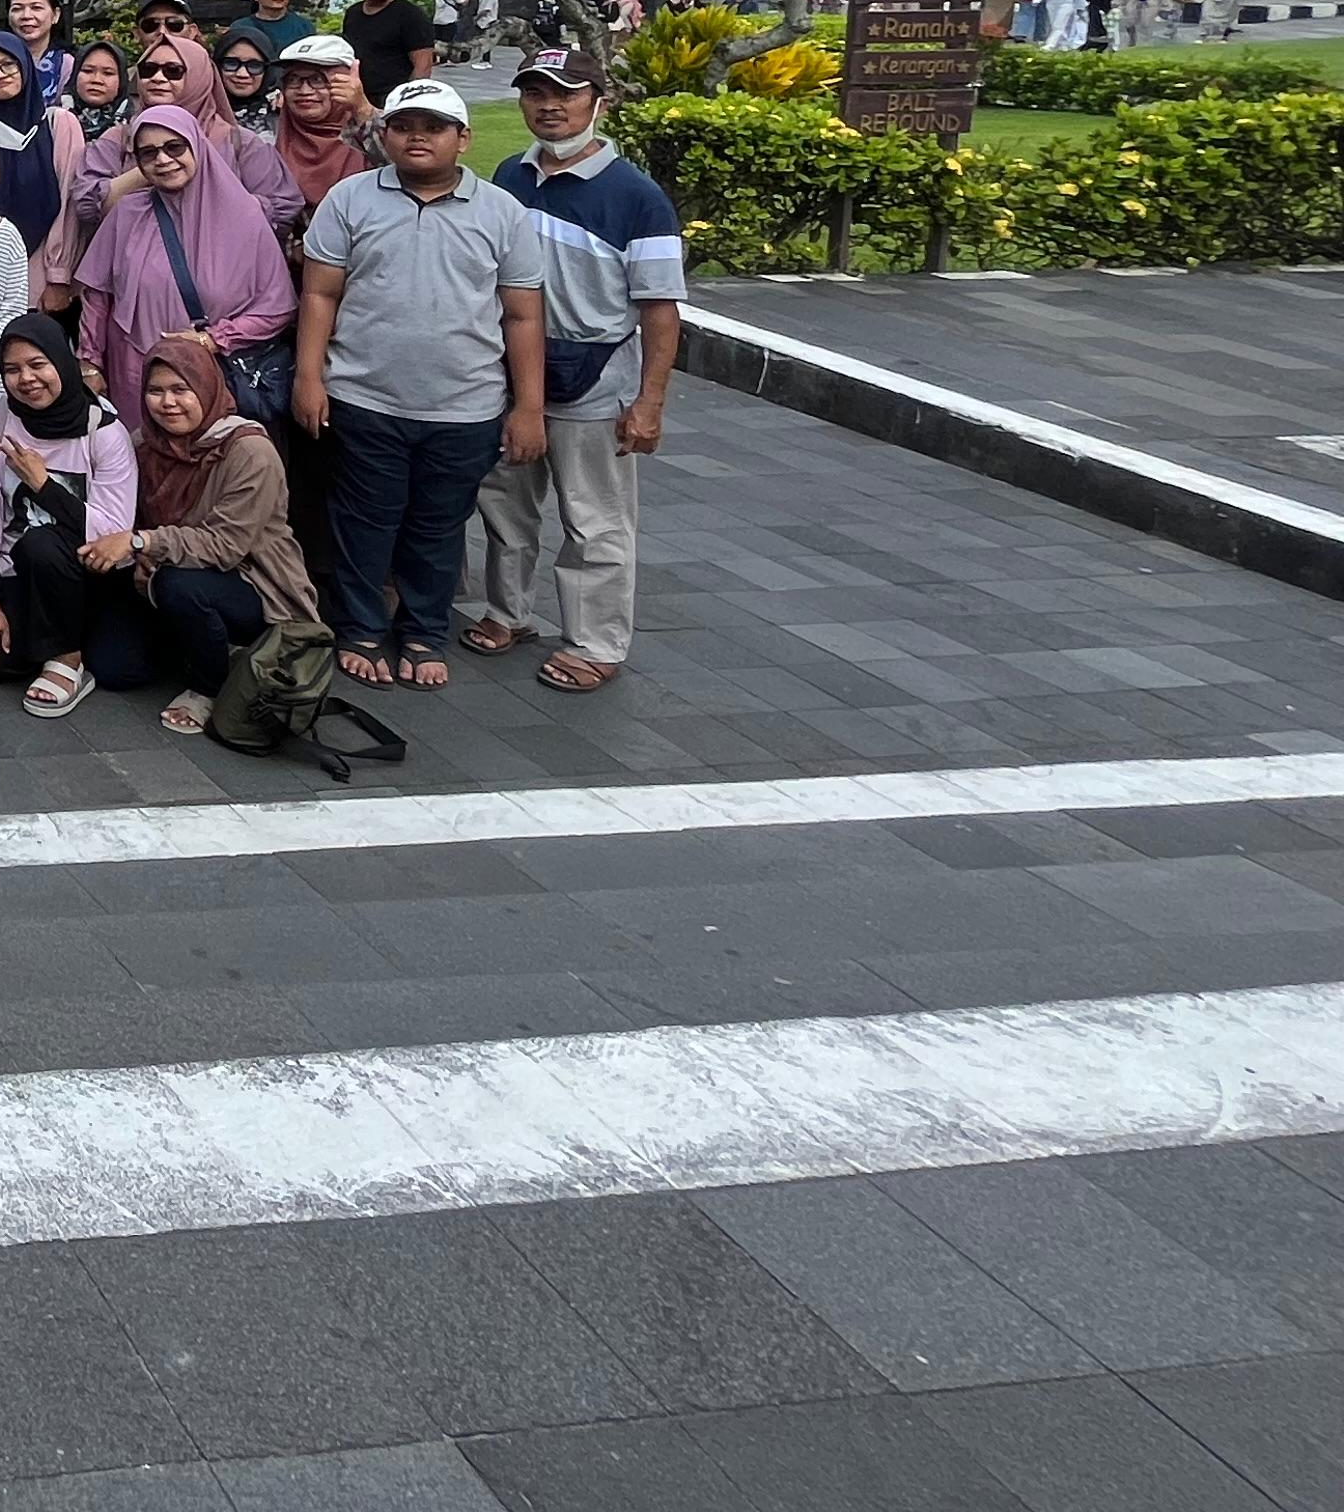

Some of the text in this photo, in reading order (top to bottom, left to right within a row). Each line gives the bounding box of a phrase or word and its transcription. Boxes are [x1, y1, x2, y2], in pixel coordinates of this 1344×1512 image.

[883, 16, 955, 38] Ramah
[878, 55, 954, 79] Kenangan
[887, 93, 936, 112] BALI
